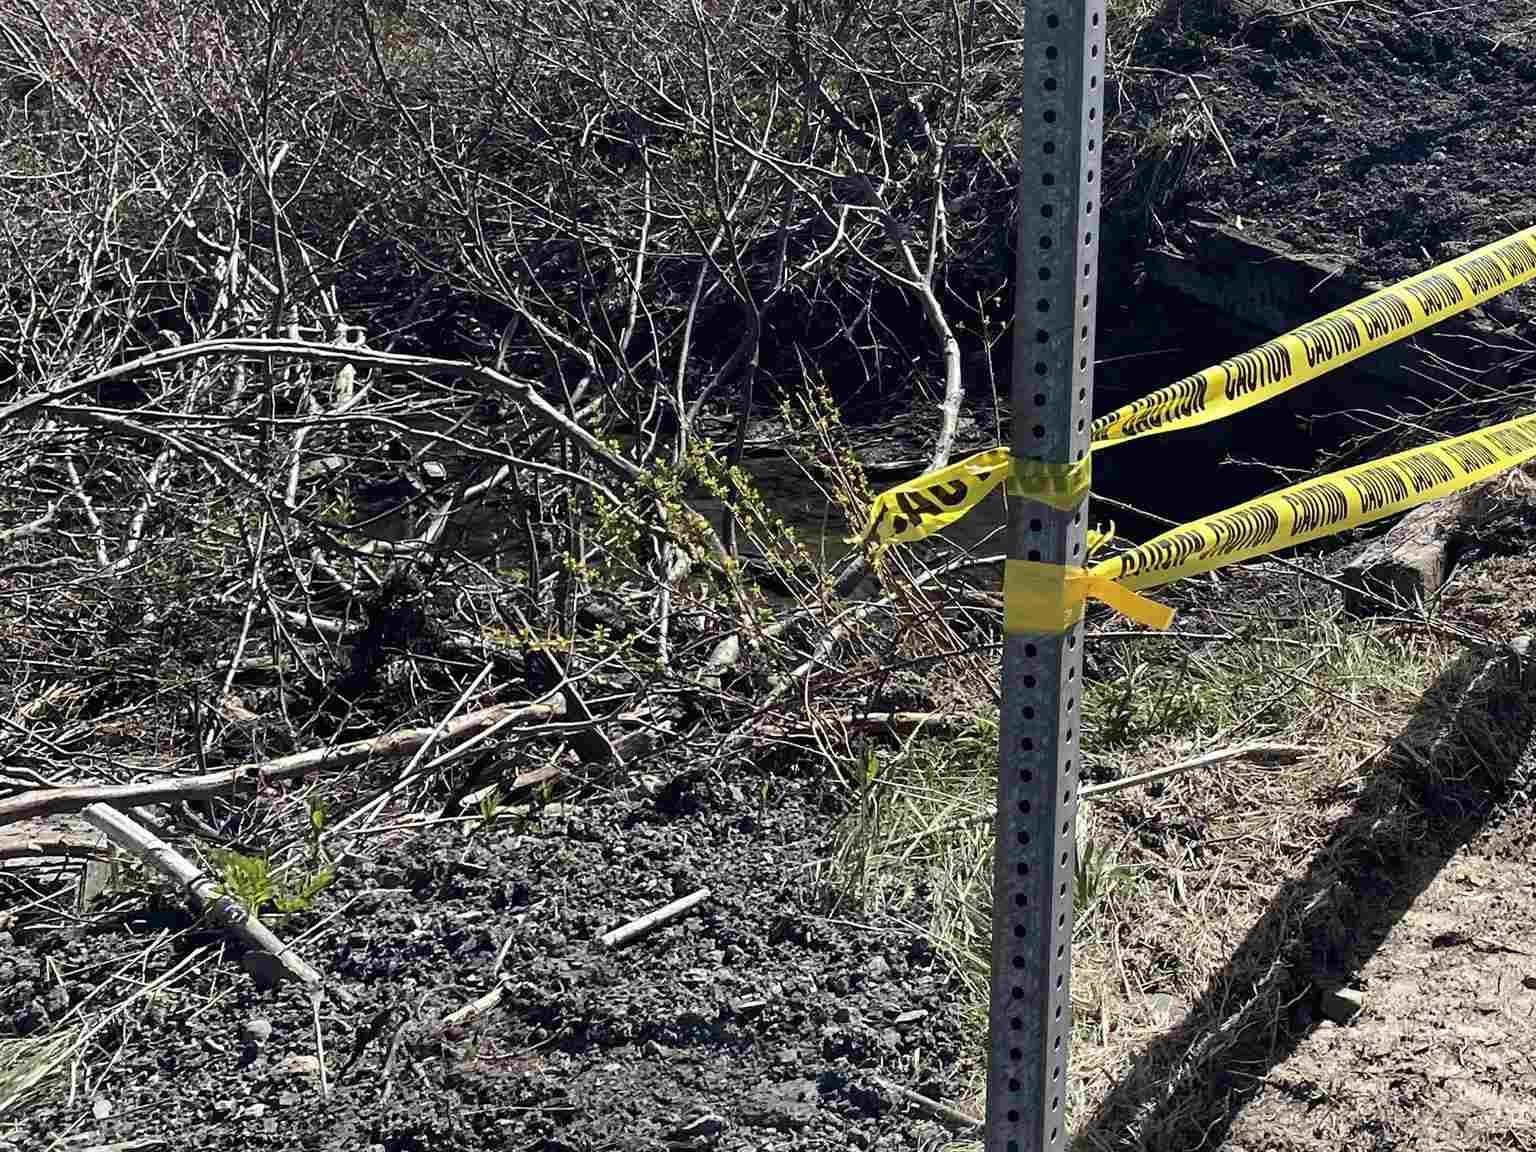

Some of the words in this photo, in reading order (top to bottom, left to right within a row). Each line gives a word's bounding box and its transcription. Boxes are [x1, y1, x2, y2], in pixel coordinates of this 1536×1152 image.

[1220, 341, 1292, 401] CAUTION
[1292, 316, 1361, 368] CAUTION
[1348, 294, 1413, 341] CAUTION
[1404, 273, 1464, 316] CAUTION
[1455, 255, 1506, 297] CAUTION
[1282, 482, 1348, 536] CAUTION
[1344, 465, 1409, 513] CAUTION
[1392, 452, 1455, 493] CAUTION
[1441, 440, 1501, 474] CAUTION
